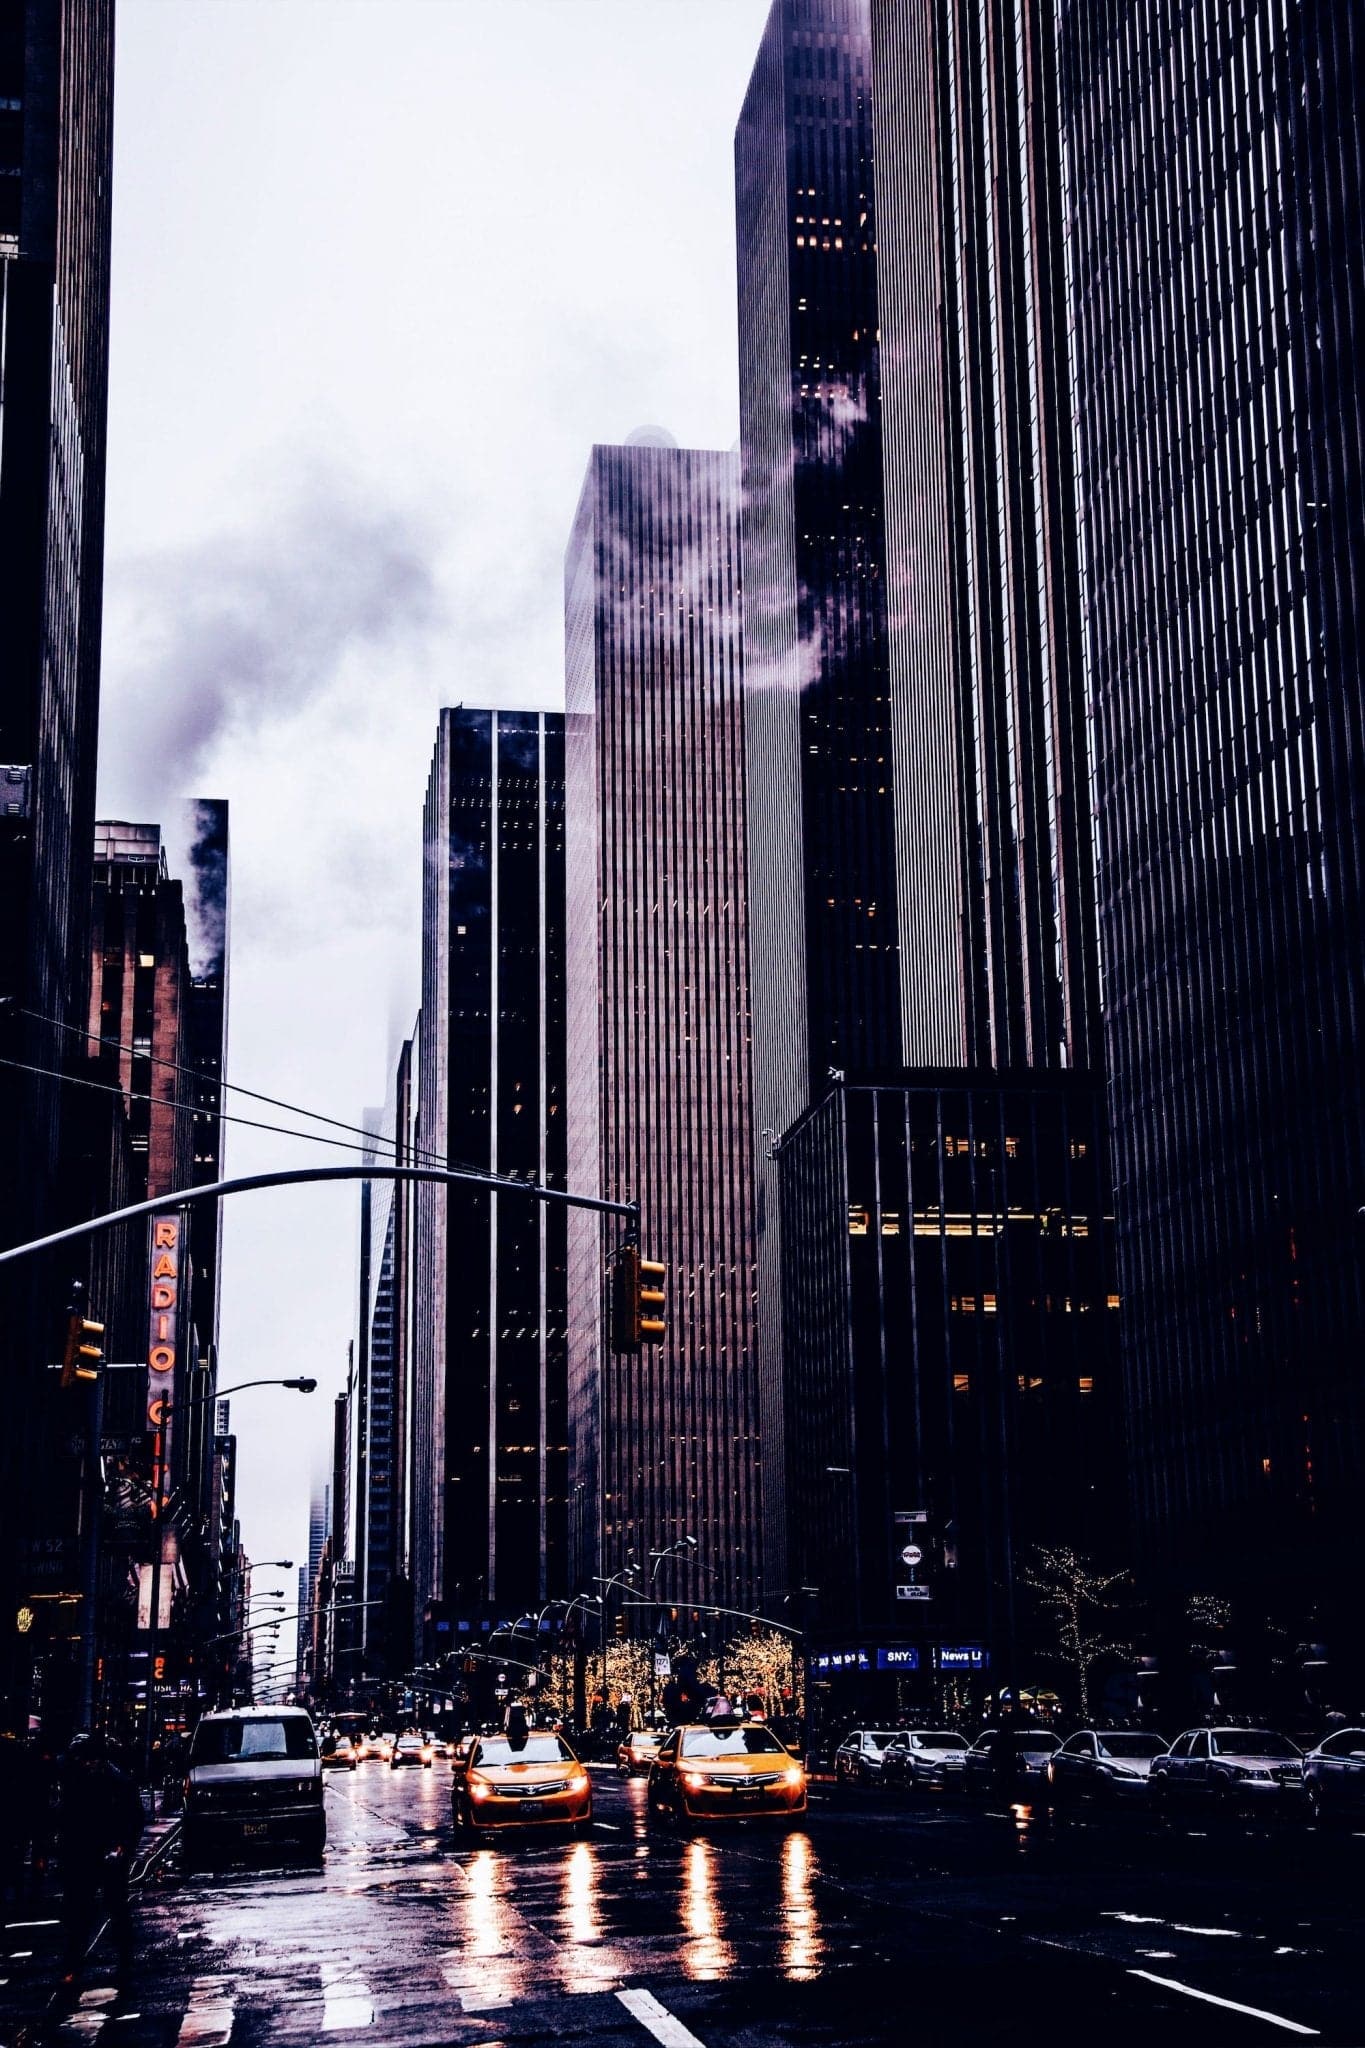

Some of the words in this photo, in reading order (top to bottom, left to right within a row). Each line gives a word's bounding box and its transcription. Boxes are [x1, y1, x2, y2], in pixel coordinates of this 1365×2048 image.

[149, 1222, 177, 1372] RADIO
[887, 1651, 912, 1662] SNY:
[941, 1651, 969, 1661] News
